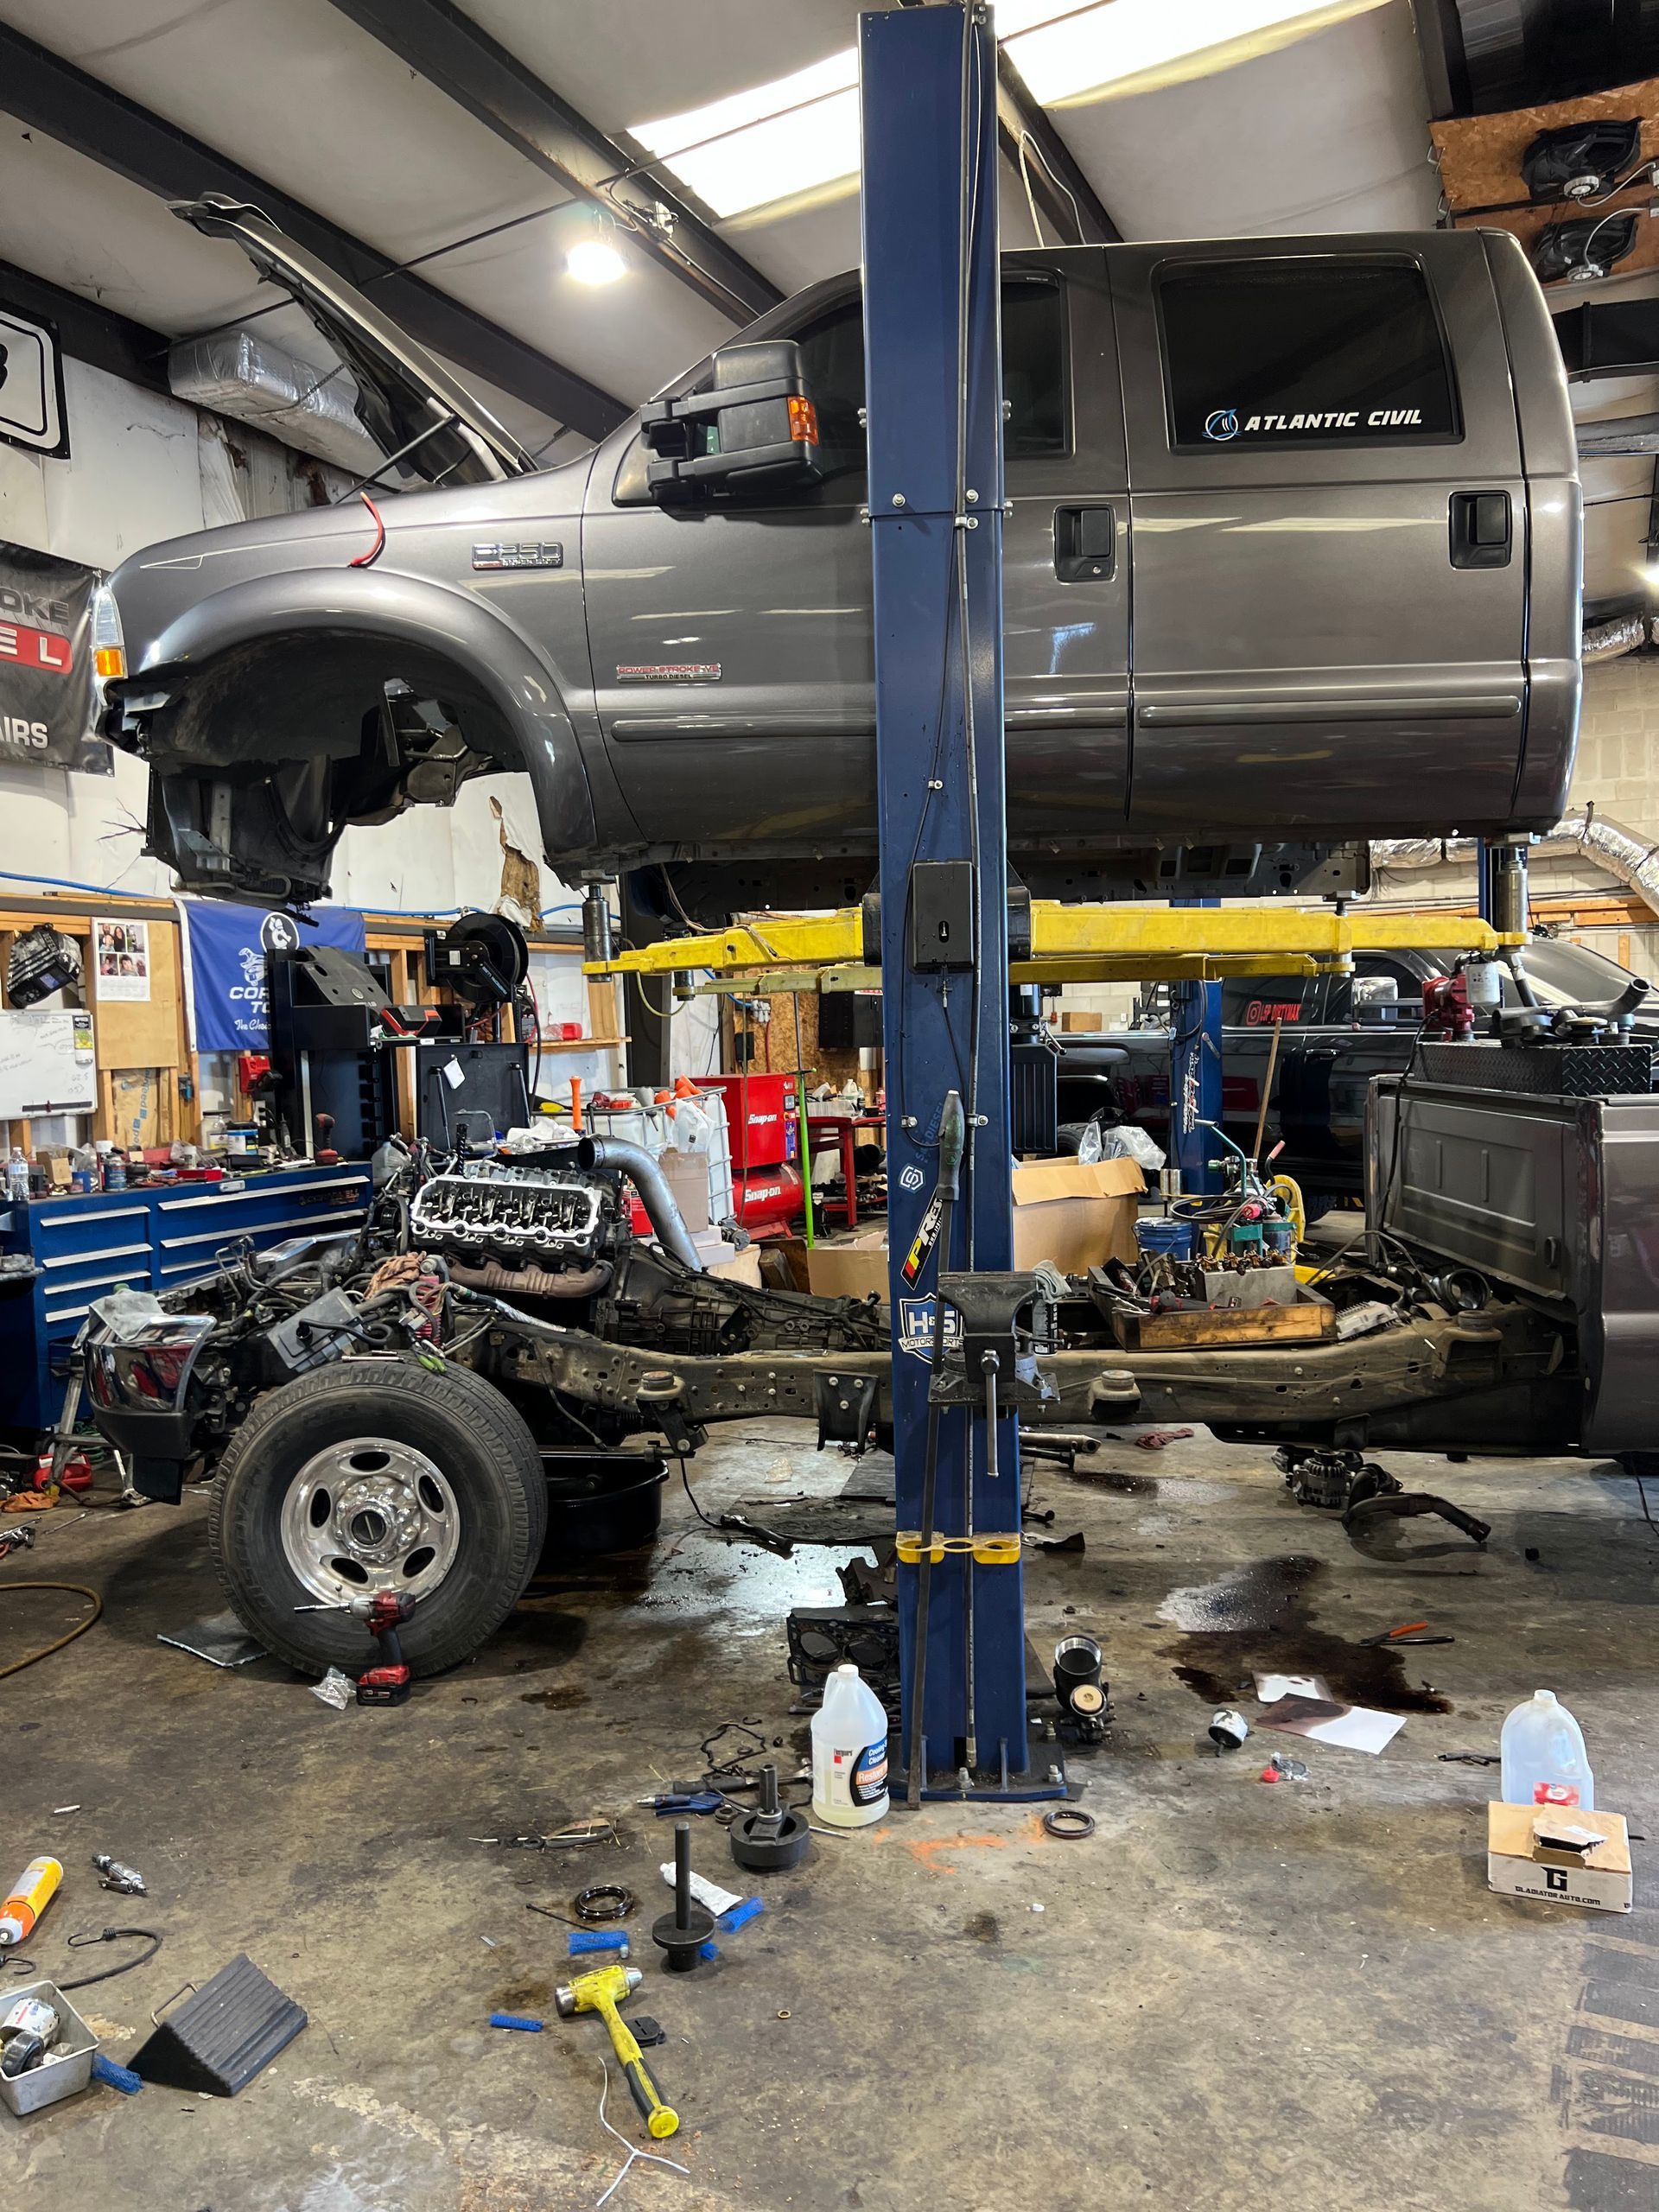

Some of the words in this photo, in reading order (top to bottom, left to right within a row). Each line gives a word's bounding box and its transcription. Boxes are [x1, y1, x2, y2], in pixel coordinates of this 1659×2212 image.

[1244, 412, 1359, 431] ATLANTIC
[1368, 410, 1422, 426] CIVIL
[619, 665, 656, 674] POWER
[658, 663, 701, 673] STROKE
[748, 1113, 777, 1125] Snap-on
[745, 1185, 781, 1203] Snap-on
[901, 1338, 964, 1348] MOTORORTS
[1515, 1885, 1558, 1898] GLADIATOR
